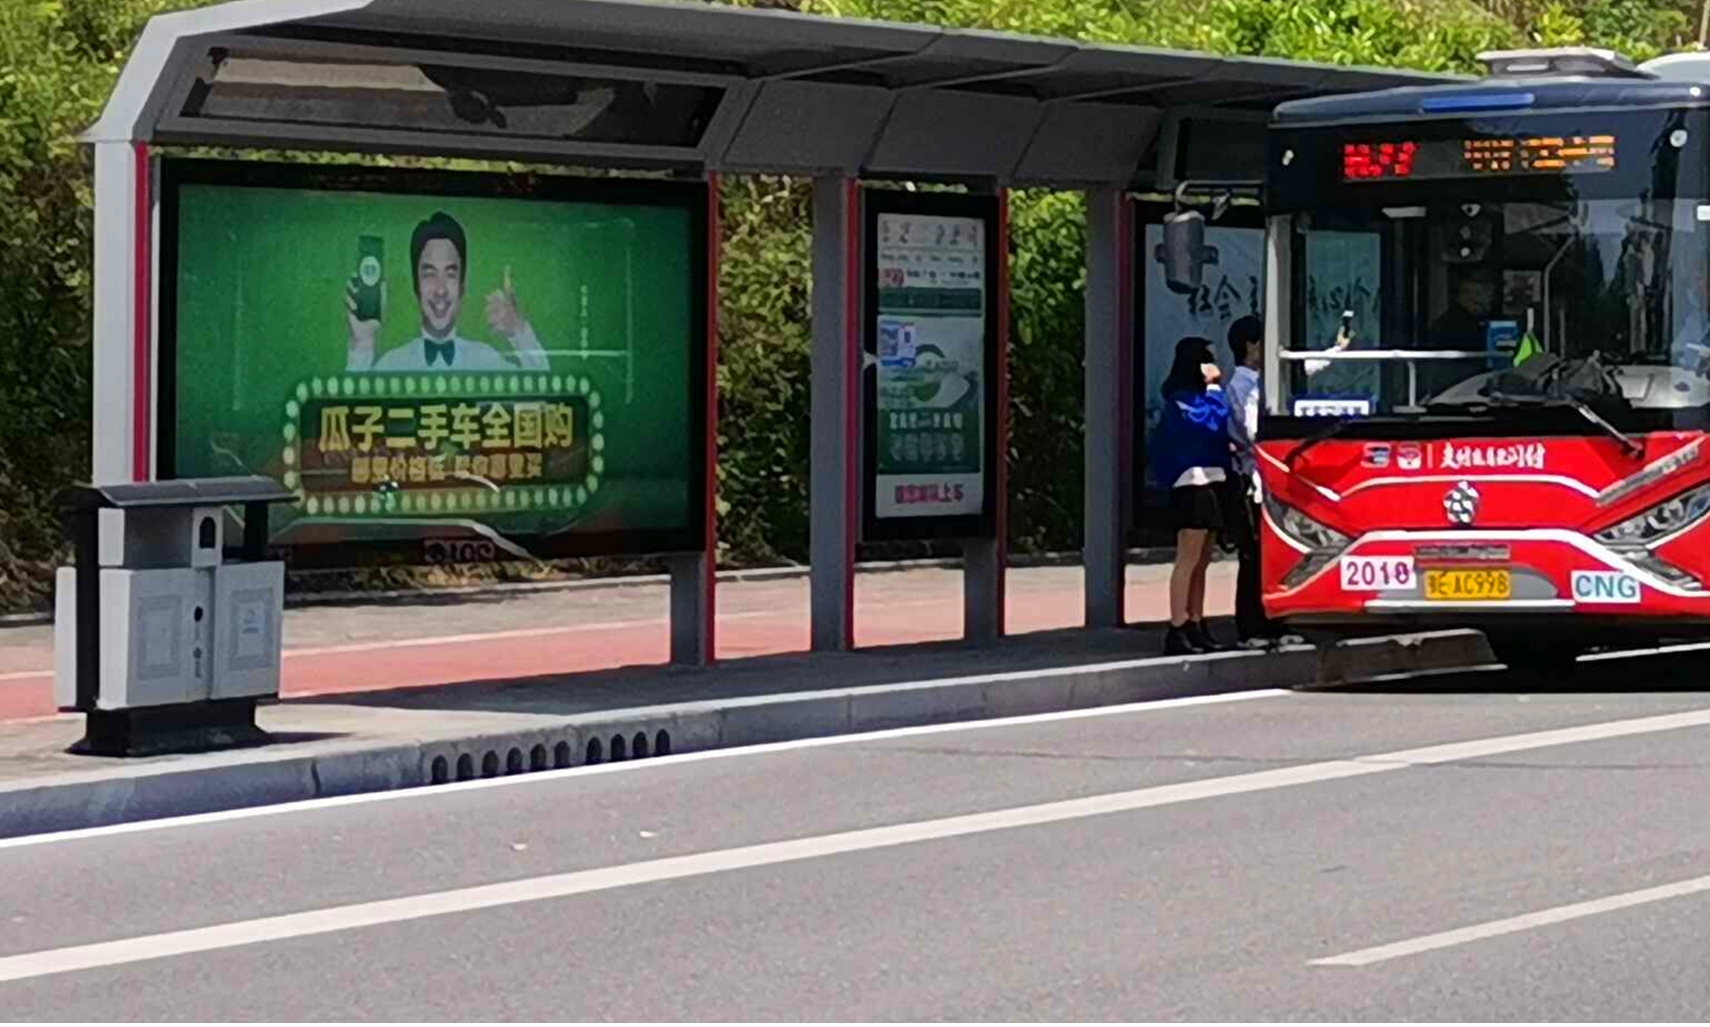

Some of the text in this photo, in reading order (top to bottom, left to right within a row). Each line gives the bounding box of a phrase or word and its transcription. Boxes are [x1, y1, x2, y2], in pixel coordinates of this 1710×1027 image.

[319, 402, 574, 452] 瓜子二手车全国购
[1346, 560, 1410, 586] 2018
[1575, 574, 1638, 599] CNG
